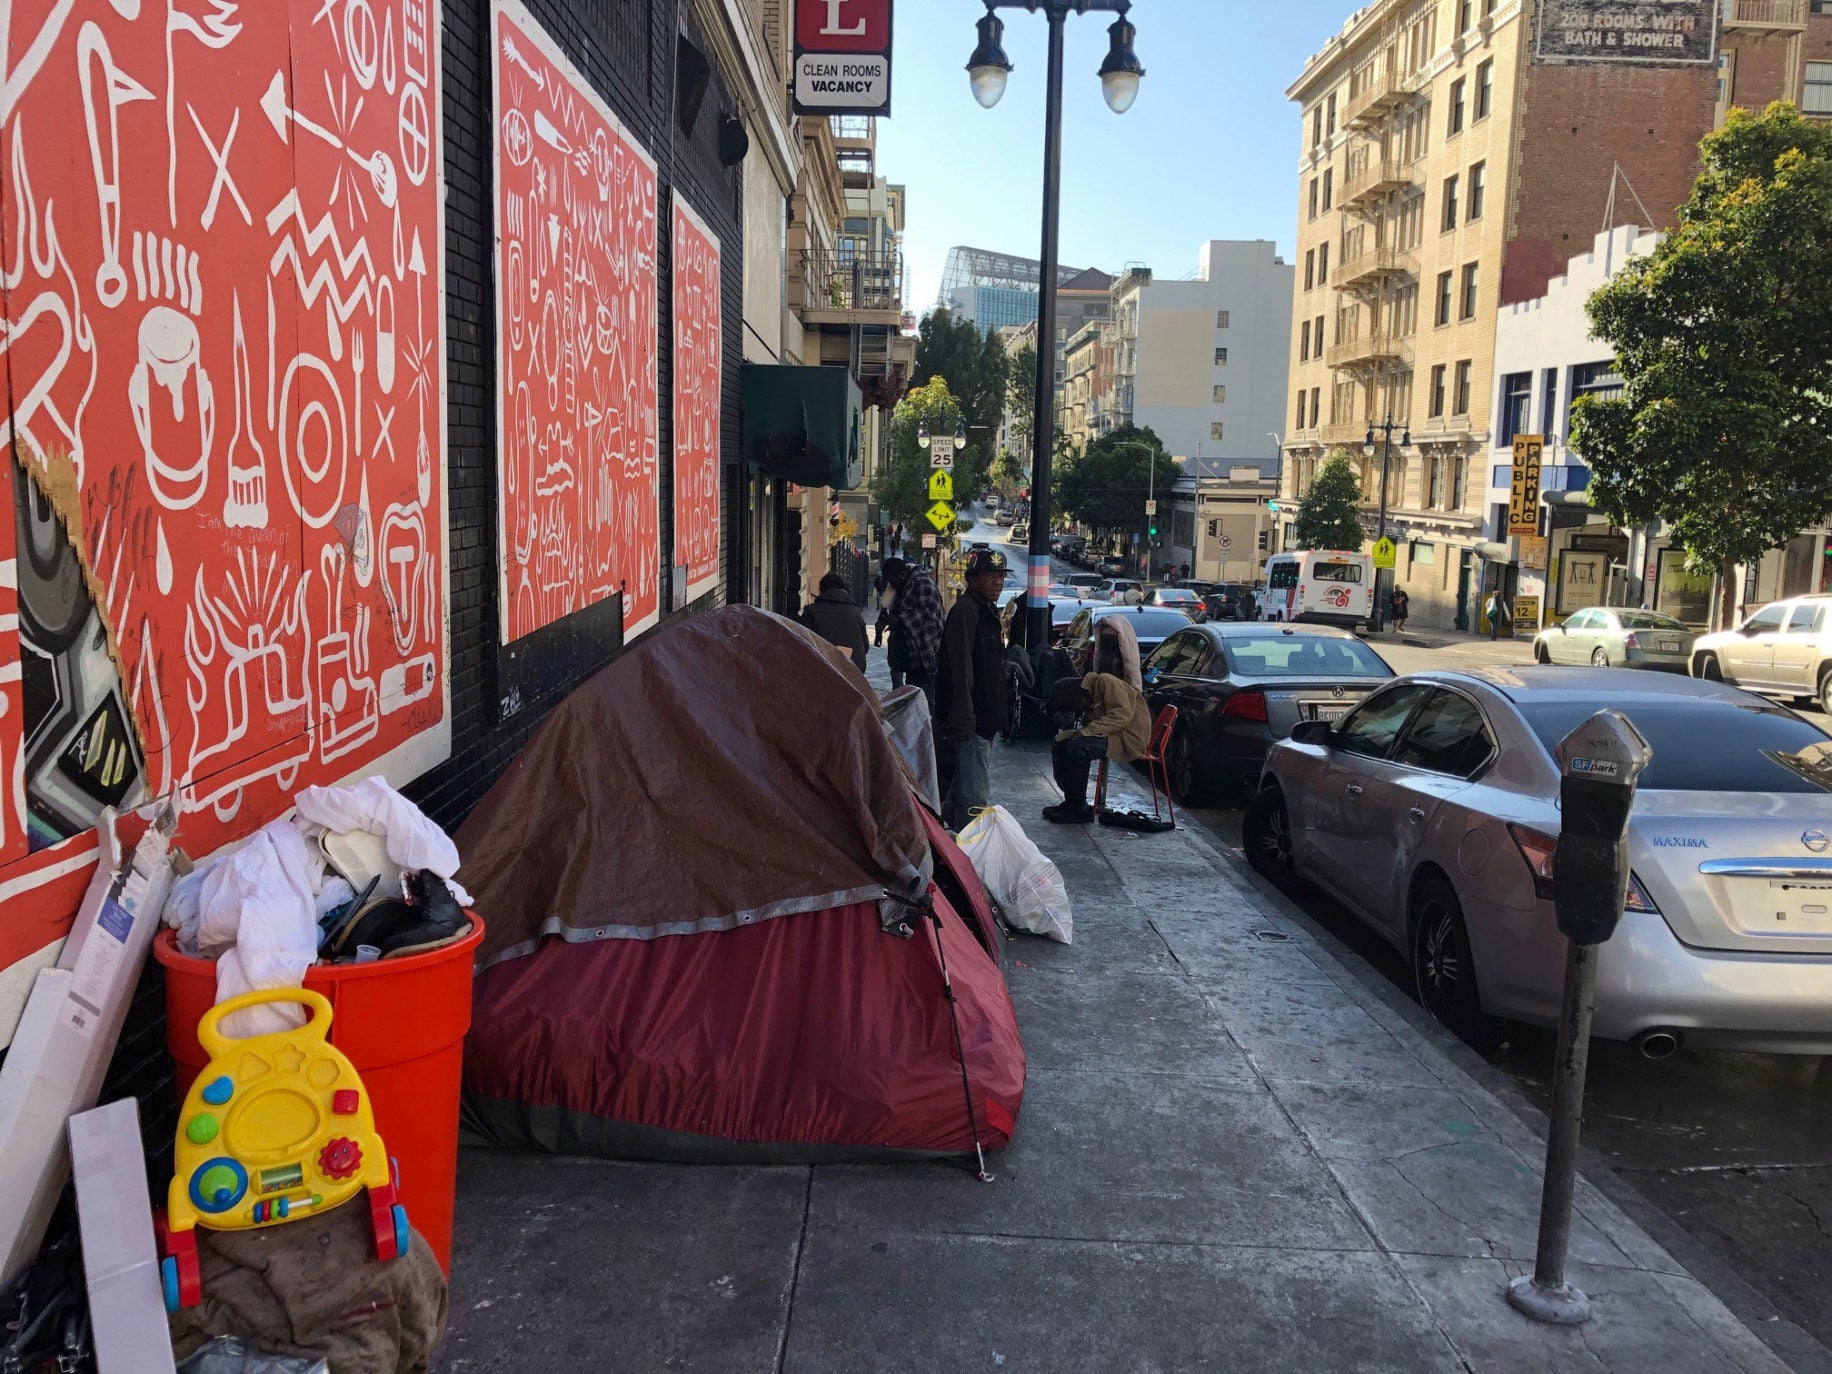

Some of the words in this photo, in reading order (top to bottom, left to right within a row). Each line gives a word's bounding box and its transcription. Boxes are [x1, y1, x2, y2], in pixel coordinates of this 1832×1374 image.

[1560, 13, 1590, 27] 200
[1594, 14, 1645, 29] ROOMS
[1652, 15, 1696, 31] WITH
[1565, 31, 1601, 45] BATH
[1606, 32, 1616, 45] &
[1623, 32, 1685, 48] SHOWER
[803, 64, 838, 76] CLEAN
[842, 65, 881, 77] ROOMS
[811, 80, 873, 93] VACANCY
[933, 454, 951, 465] 25
[1509, 442, 1525, 524] PUBLIC
[1522, 445, 1540, 522] PARKING
[1515, 607, 1528, 617] 12
[1653, 837, 1709, 848] MAXIMA
